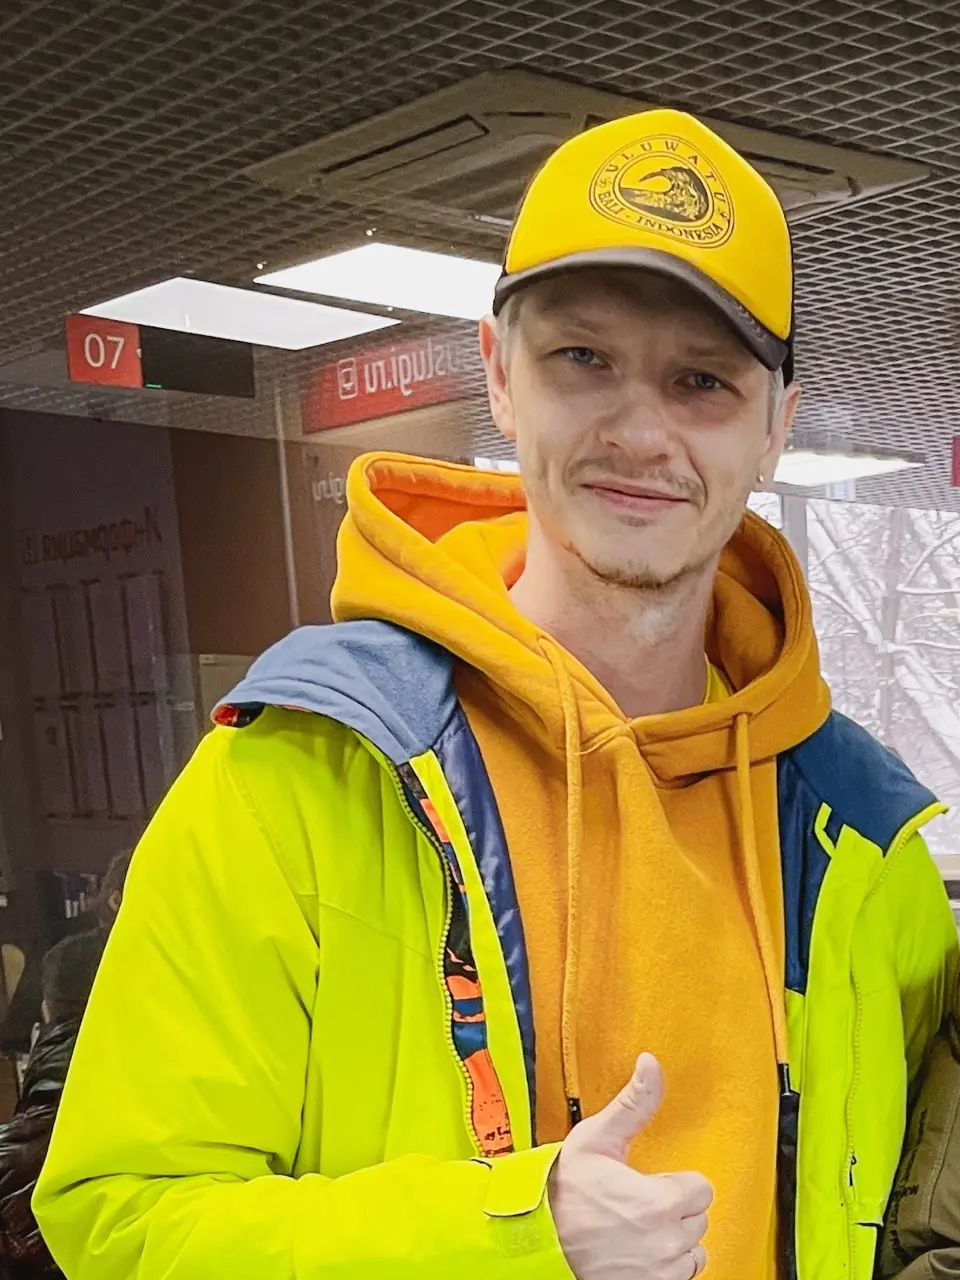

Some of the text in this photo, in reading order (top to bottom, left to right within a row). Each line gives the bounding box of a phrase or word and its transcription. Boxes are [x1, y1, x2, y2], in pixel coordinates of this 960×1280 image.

[605, 140, 726, 203] ULUWATU
[598, 192, 625, 215] BALI
[636, 216, 724, 240] INDONESIA
[84, 333, 125, 370] 07
